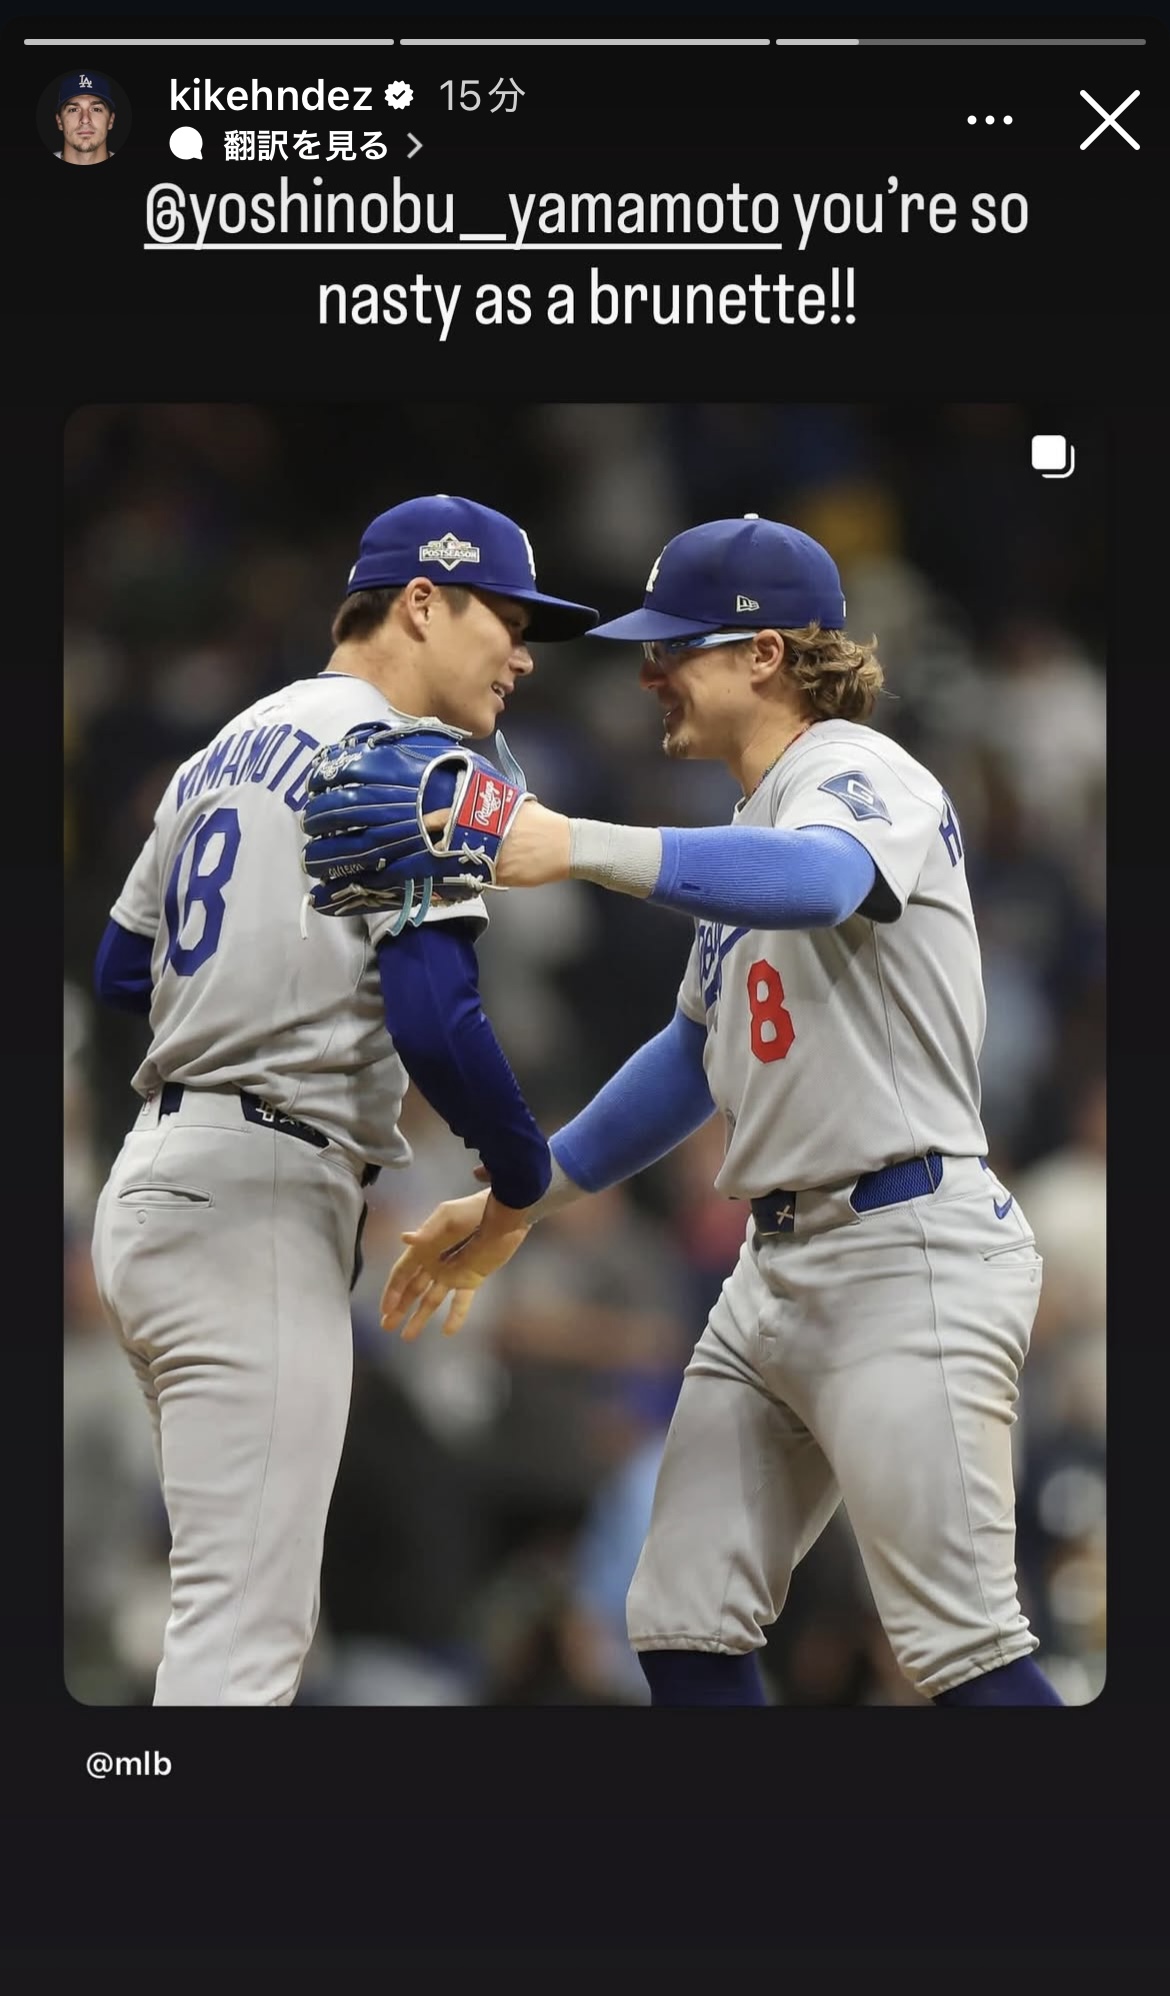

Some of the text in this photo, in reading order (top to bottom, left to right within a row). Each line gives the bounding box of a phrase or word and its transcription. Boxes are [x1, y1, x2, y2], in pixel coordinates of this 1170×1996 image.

[78, 74, 93, 89] LA
[422, 548, 478, 559] POSTSEASON
[474, 780, 502, 827] Rawlings
[161, 807, 242, 978] 18
[747, 959, 796, 1064] 8
